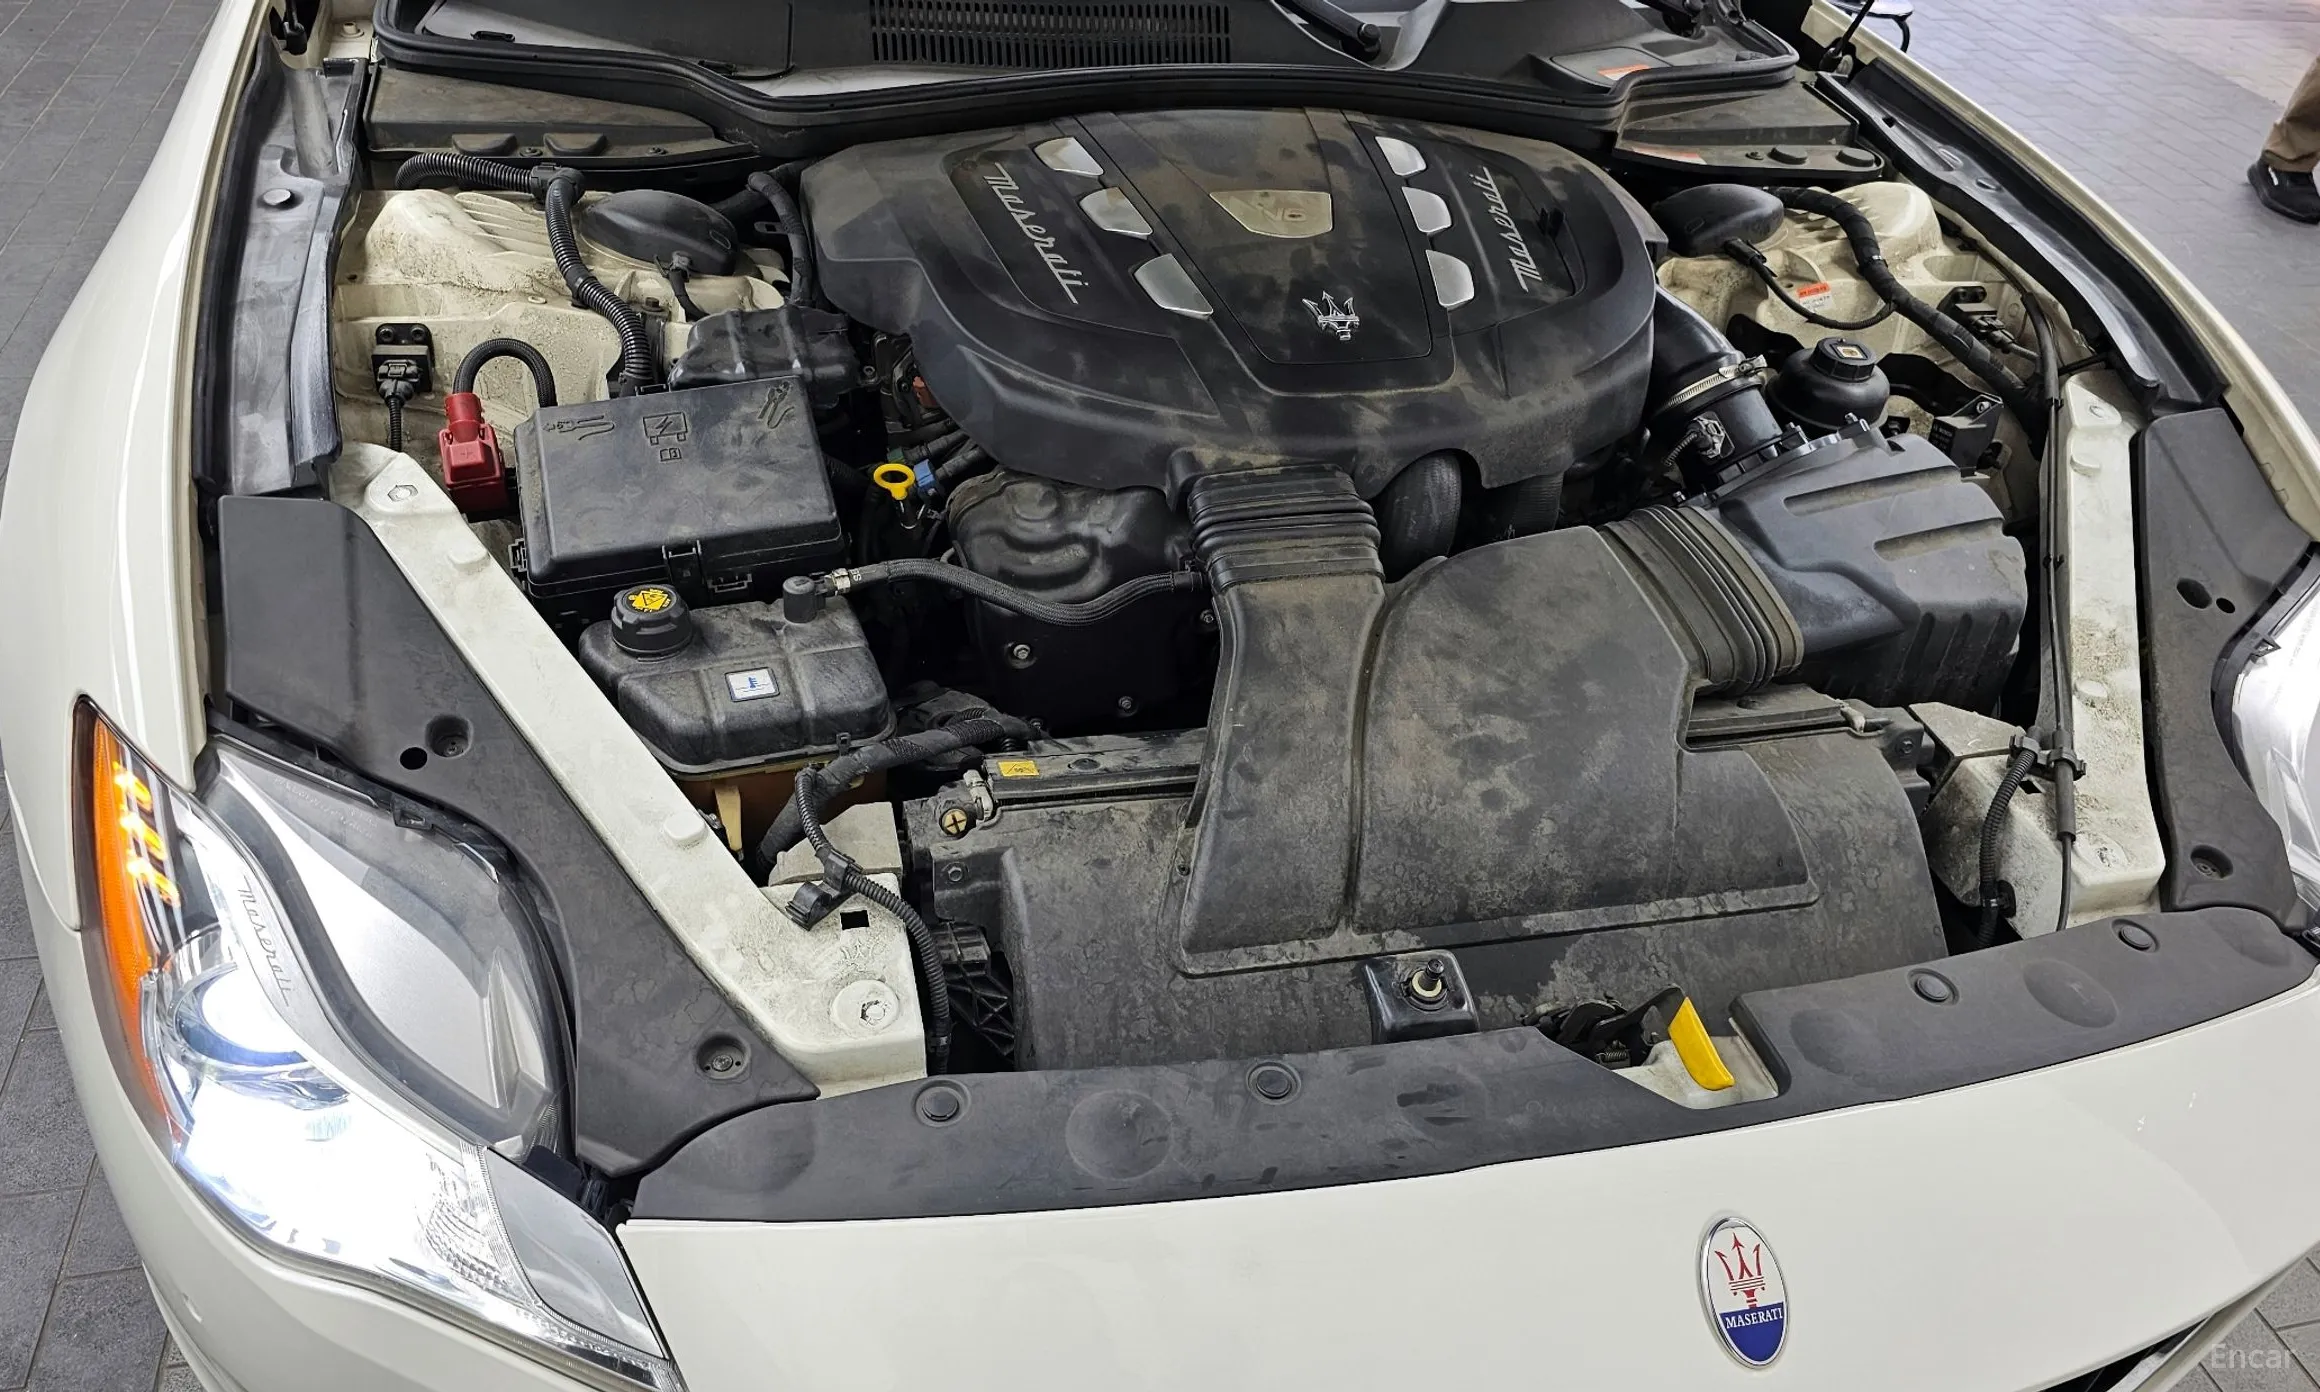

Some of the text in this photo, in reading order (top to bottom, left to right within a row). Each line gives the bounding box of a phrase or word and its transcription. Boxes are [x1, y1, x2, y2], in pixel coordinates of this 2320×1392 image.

[983, 162, 1089, 305] Maserati
[1469, 166, 1543, 293] Maserati
[237, 875, 295, 1007] Maserati
[1725, 1307, 1783, 1329] MASERATI
